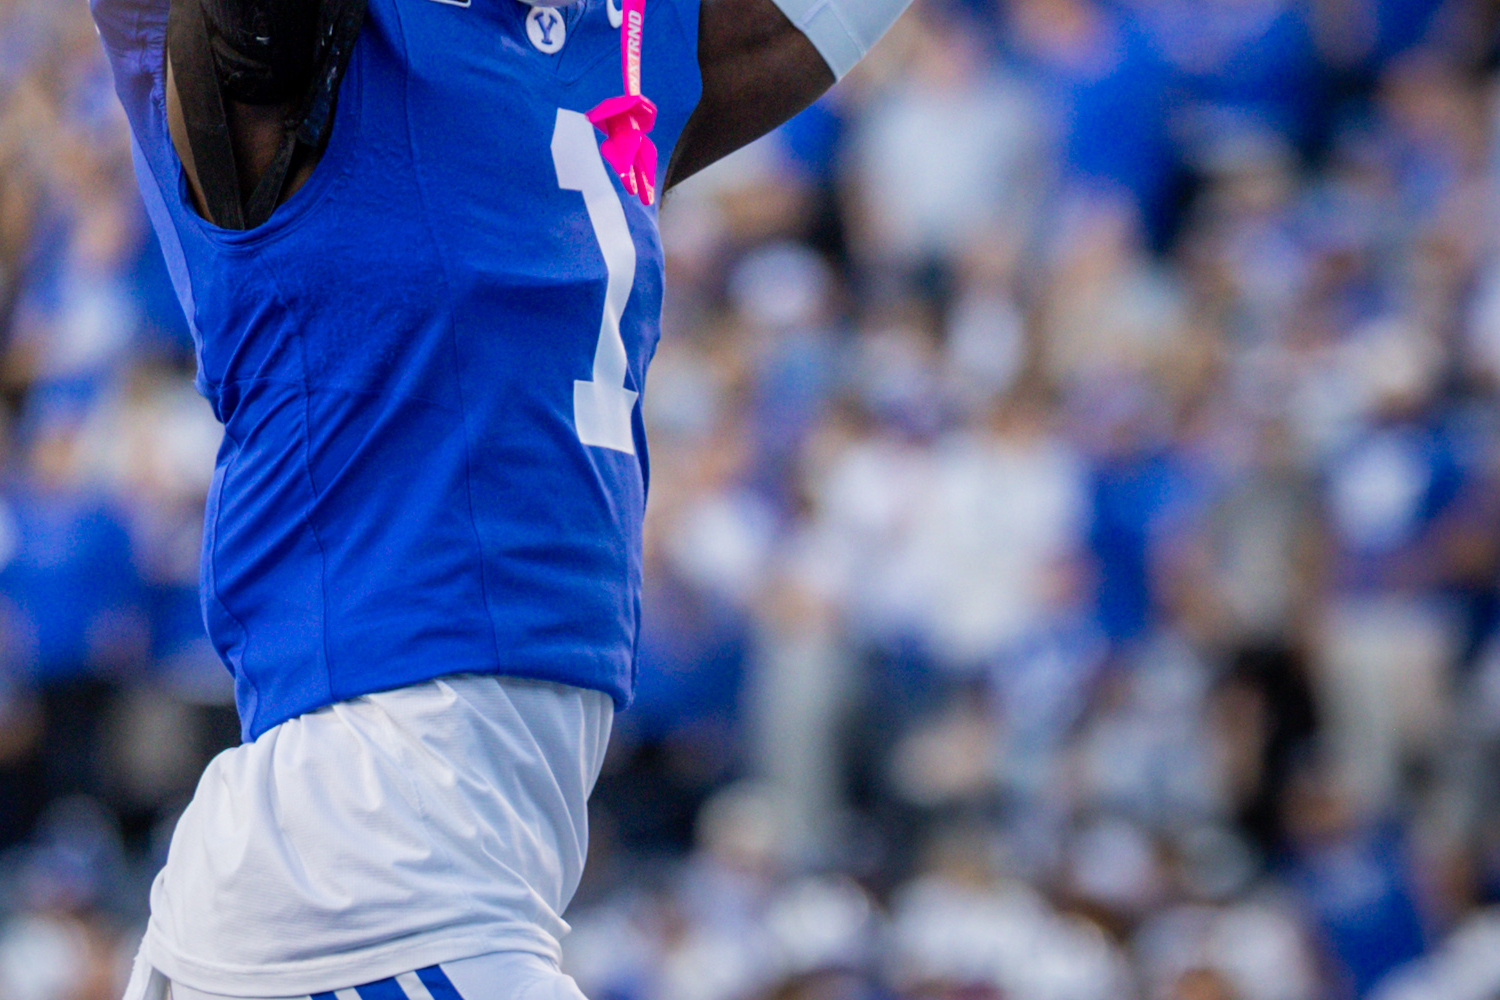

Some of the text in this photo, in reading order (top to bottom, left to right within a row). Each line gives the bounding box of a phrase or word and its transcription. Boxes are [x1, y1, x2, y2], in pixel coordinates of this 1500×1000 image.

[533, 11, 558, 46] Y
[627, 9, 642, 97] NXTRND
[550, 107, 639, 455] 1
